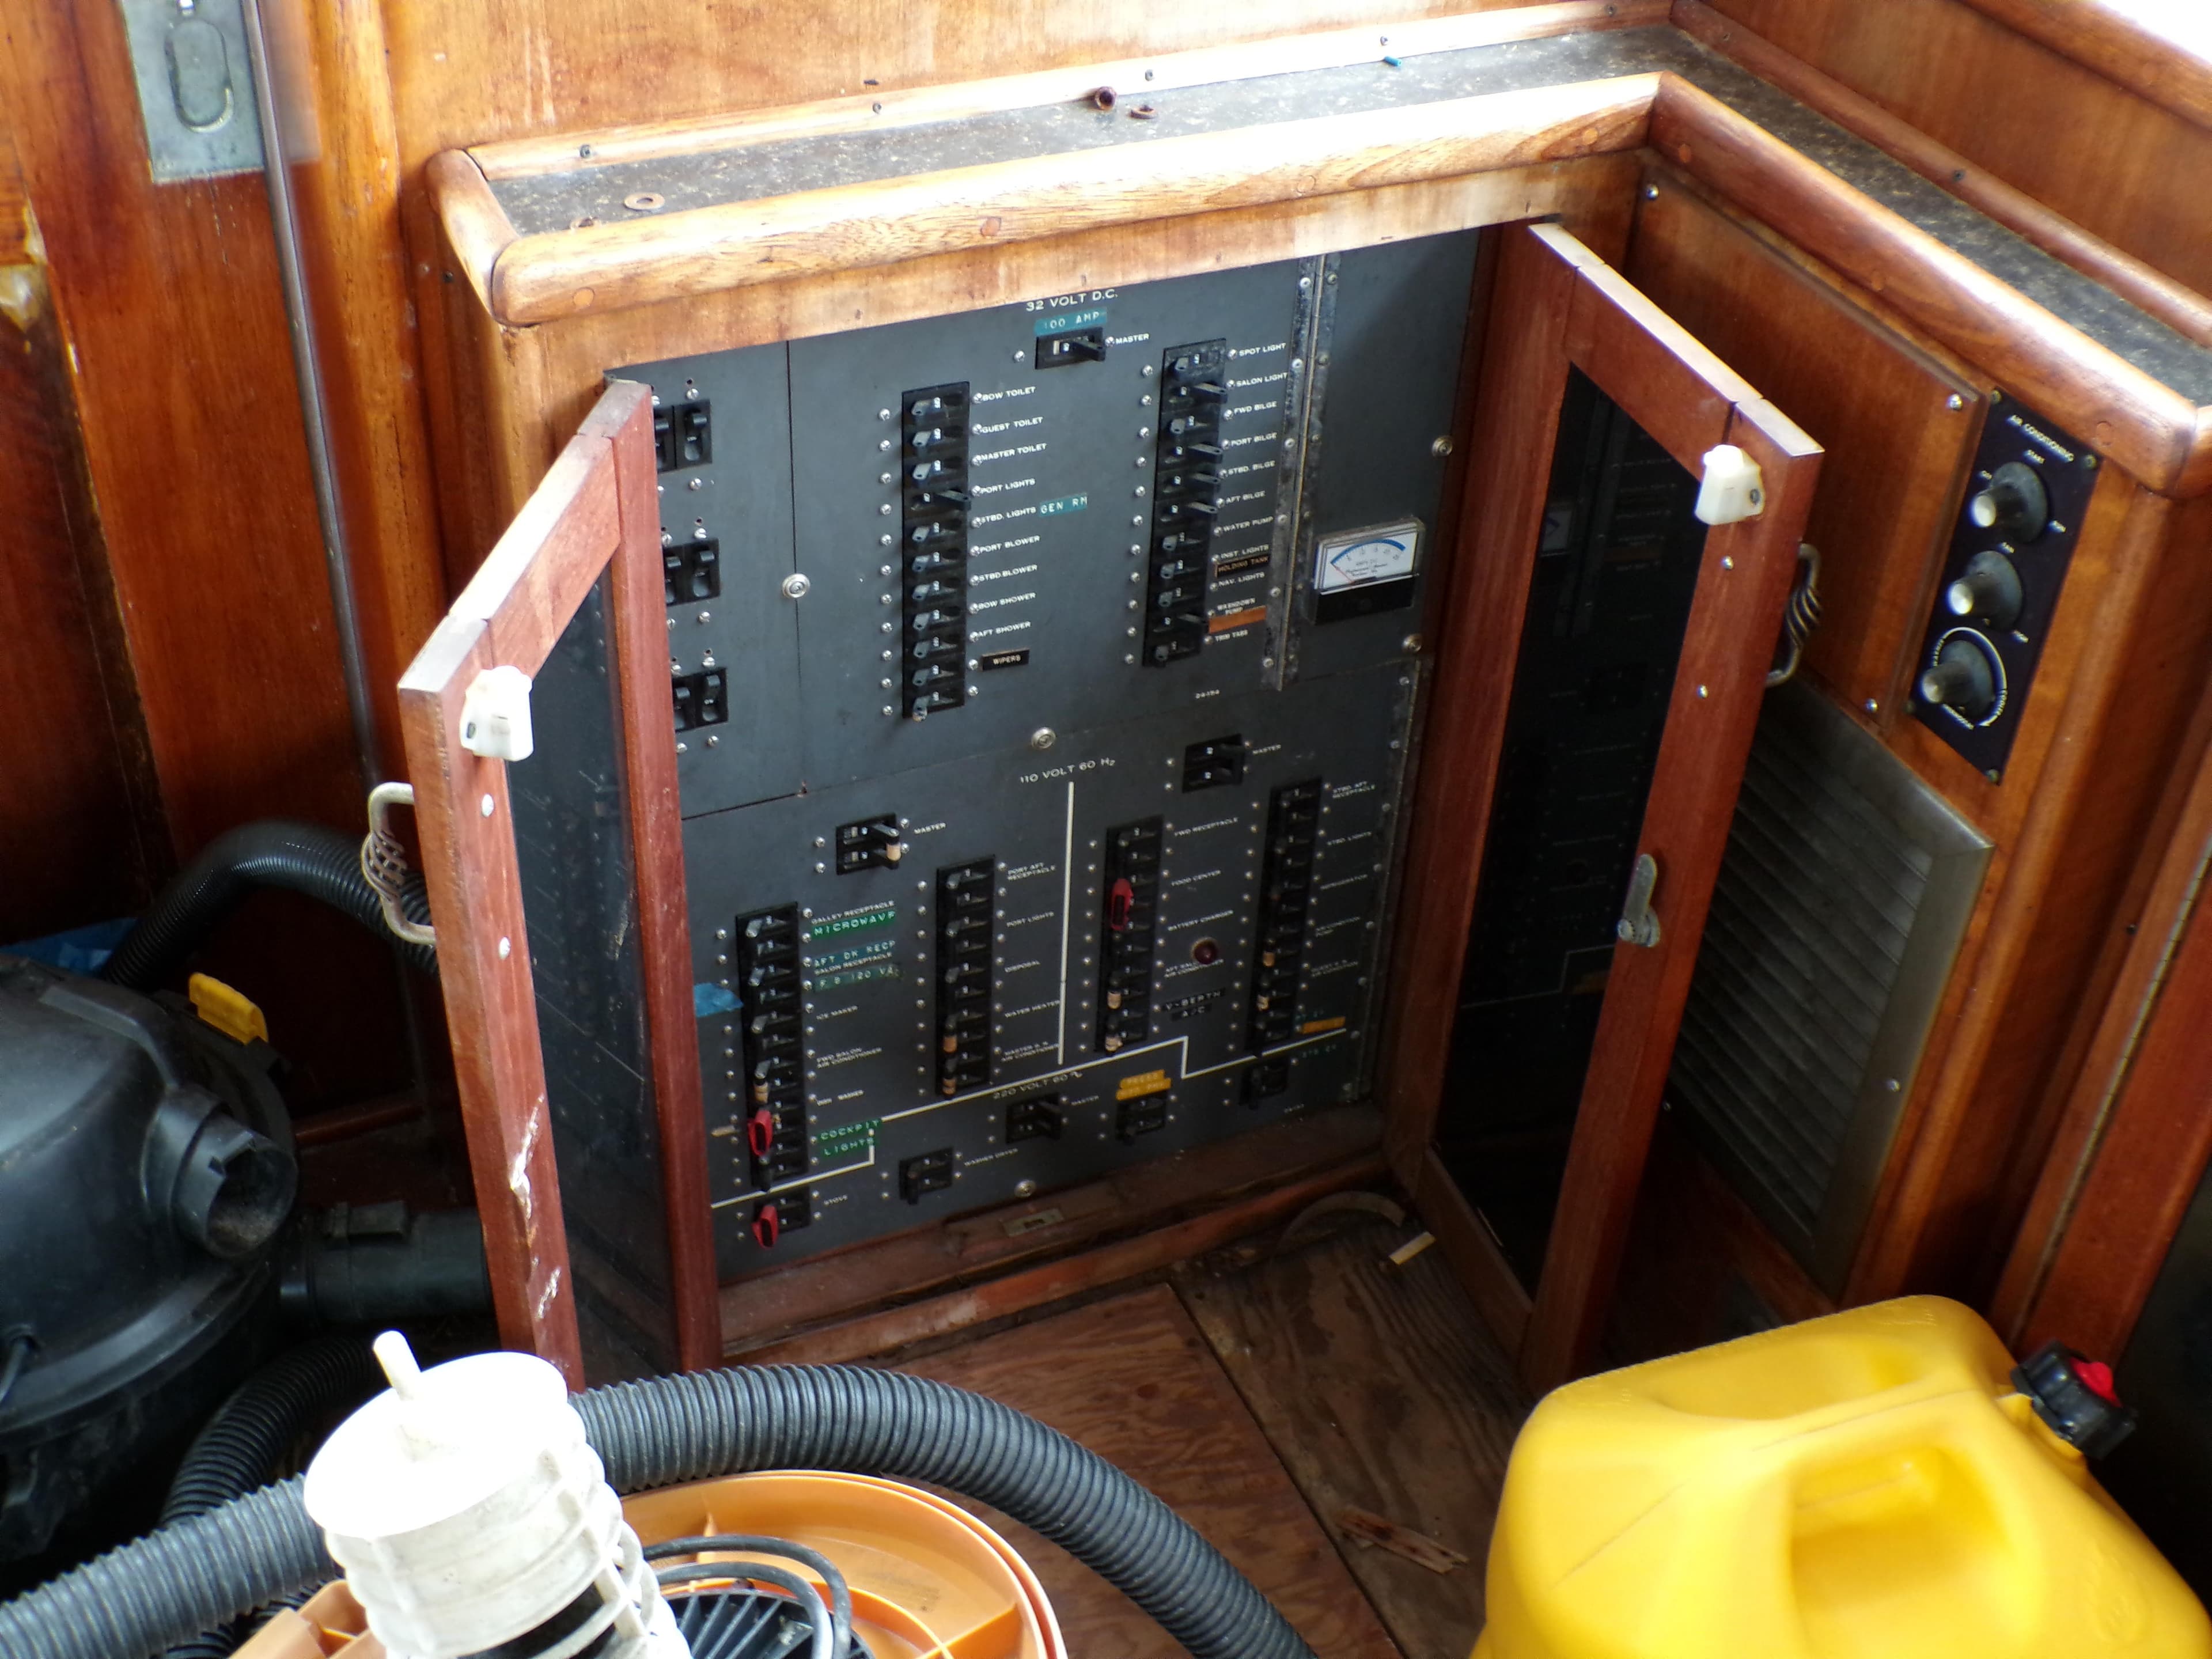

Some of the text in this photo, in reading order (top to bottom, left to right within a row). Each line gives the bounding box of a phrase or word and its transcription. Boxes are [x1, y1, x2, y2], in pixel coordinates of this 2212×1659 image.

[1026, 289, 1118, 312] 32 VOLT D.C.
[1075, 311, 1100, 324] AMP
[1115, 333, 1150, 345] MASTER
[1239, 343, 1286, 357] SPOT LIGHT
[1236, 372, 1288, 388] SALON LIGHT
[982, 386, 1036, 402] BOW TOILET
[1234, 401, 1277, 415] FWD BILGE
[981, 416, 1043, 434] GUEST TOILET
[1231, 432, 1278, 447] PORT BILGE
[2023, 423, 2074, 463] CONDITIONING
[980, 442, 1048, 461] MASTER TOILET
[1252, 460, 1276, 471] BILGE
[980, 478, 1036, 494] PORT LIGHTS
[1040, 495, 1088, 514] GEN RM
[1226, 490, 1266, 504] AFT BILGE
[1006, 506, 1037, 519] LIGHTS
[1223, 521, 1251, 532] WATER
[979, 535, 1040, 553] PORT BLOWER
[1241, 544, 1269, 555] LIGHTS
[1238, 571, 1265, 583] LIGHTS
[979, 592, 1036, 610] BOW SHOWER
[978, 621, 1031, 637] AFT SHOWER
[993, 654, 1021, 665] WIPERS
[1020, 774, 1039, 783] 110
[1042, 764, 1075, 779] VOLT
[1079, 760, 1096, 771] 60
[914, 822, 946, 835] MASTER
[843, 900, 895, 917] RECEPTACLE
[814, 955, 835, 968] AFT
[866, 940, 896, 953] RECP
[842, 951, 893, 968] RECEPTACLE
[1020, 1079, 1048, 1092] VOLT
[821, 1119, 880, 1141] COCKPIT
[824, 1137, 874, 1156] LIGHTS
